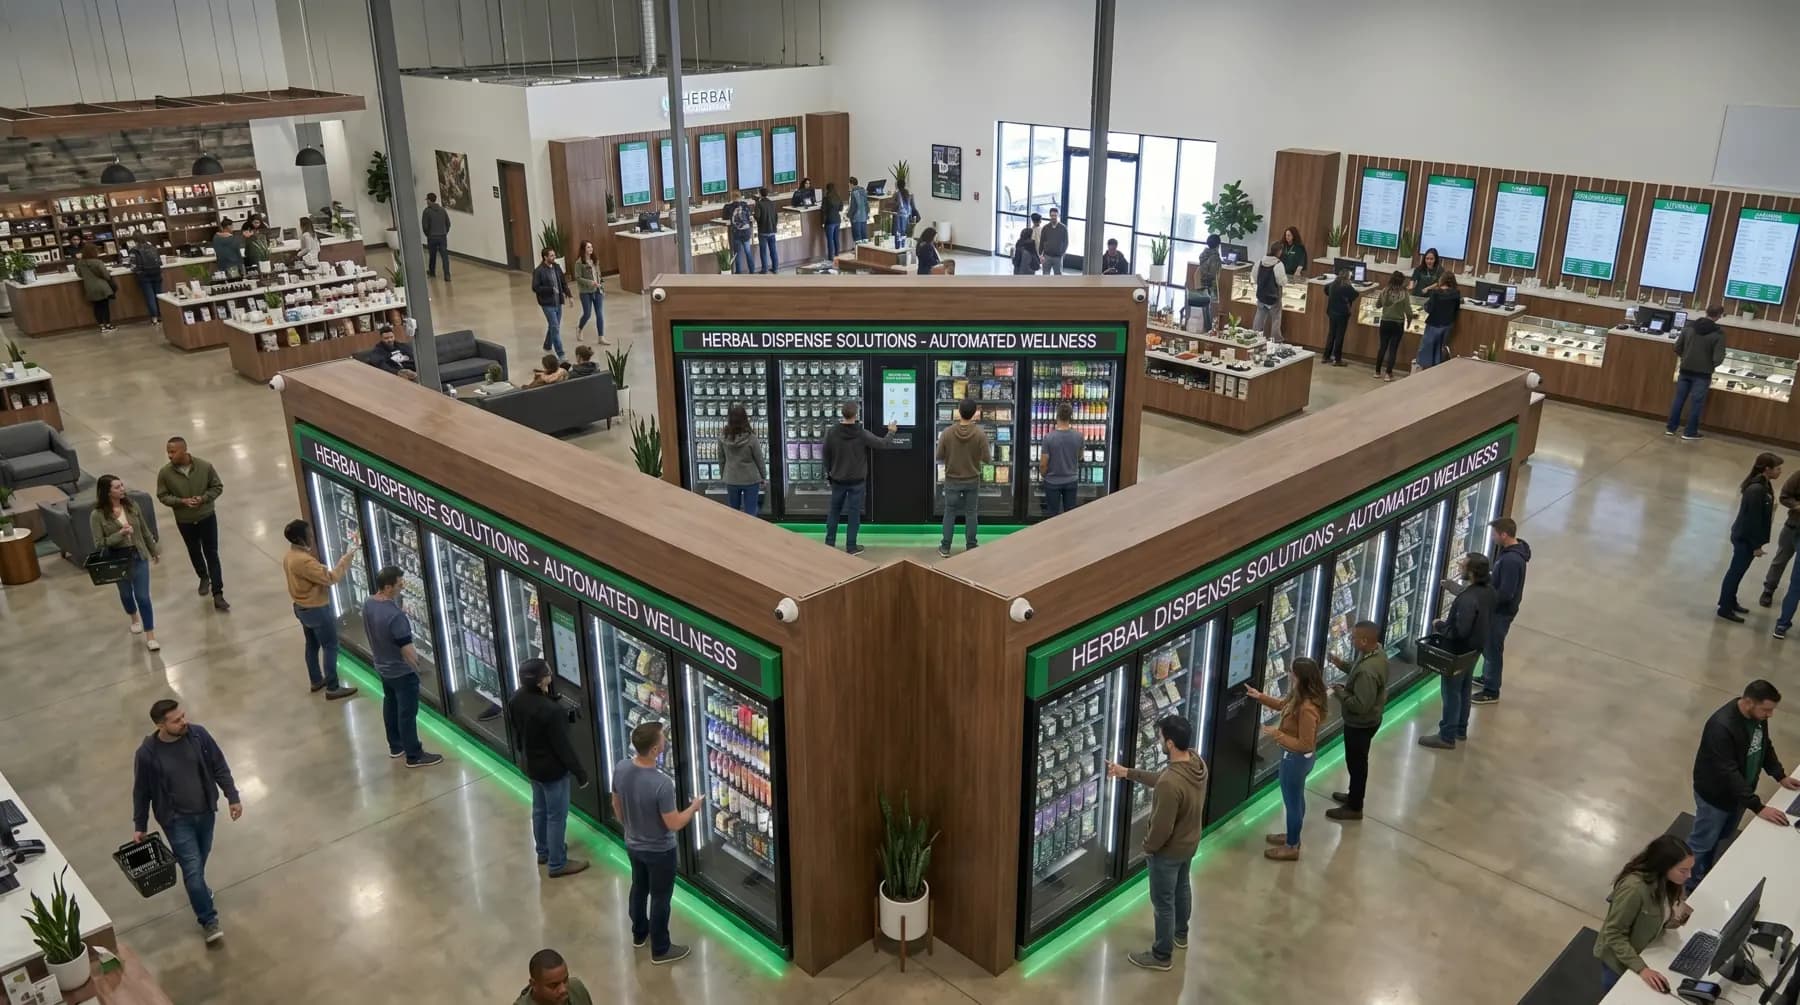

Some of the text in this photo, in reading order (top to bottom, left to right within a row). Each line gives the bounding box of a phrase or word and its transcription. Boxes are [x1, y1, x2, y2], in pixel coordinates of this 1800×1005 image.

[702, 332, 758, 348] HERBAL
[762, 332, 833, 348] DISPENSE
[836, 332, 917, 348] SOLUTIONS
[929, 333, 1016, 349] AUTOMATED
[1020, 333, 1097, 349] WELLNESS
[314, 442, 366, 484] HERBAL
[367, 468, 438, 520] DISPENSE
[440, 503, 530, 566] SOLUTIONS
[544, 556, 639, 620] AUTOMATED
[642, 604, 738, 671] WELLNESS
[1072, 616, 1149, 672] HERBAL
[1154, 567, 1242, 631] DISPENSE
[1246, 523, 1335, 584] SOLUTIONS
[1346, 476, 1431, 535] AUTOMATED
[1433, 441, 1499, 490] WELLNESS
